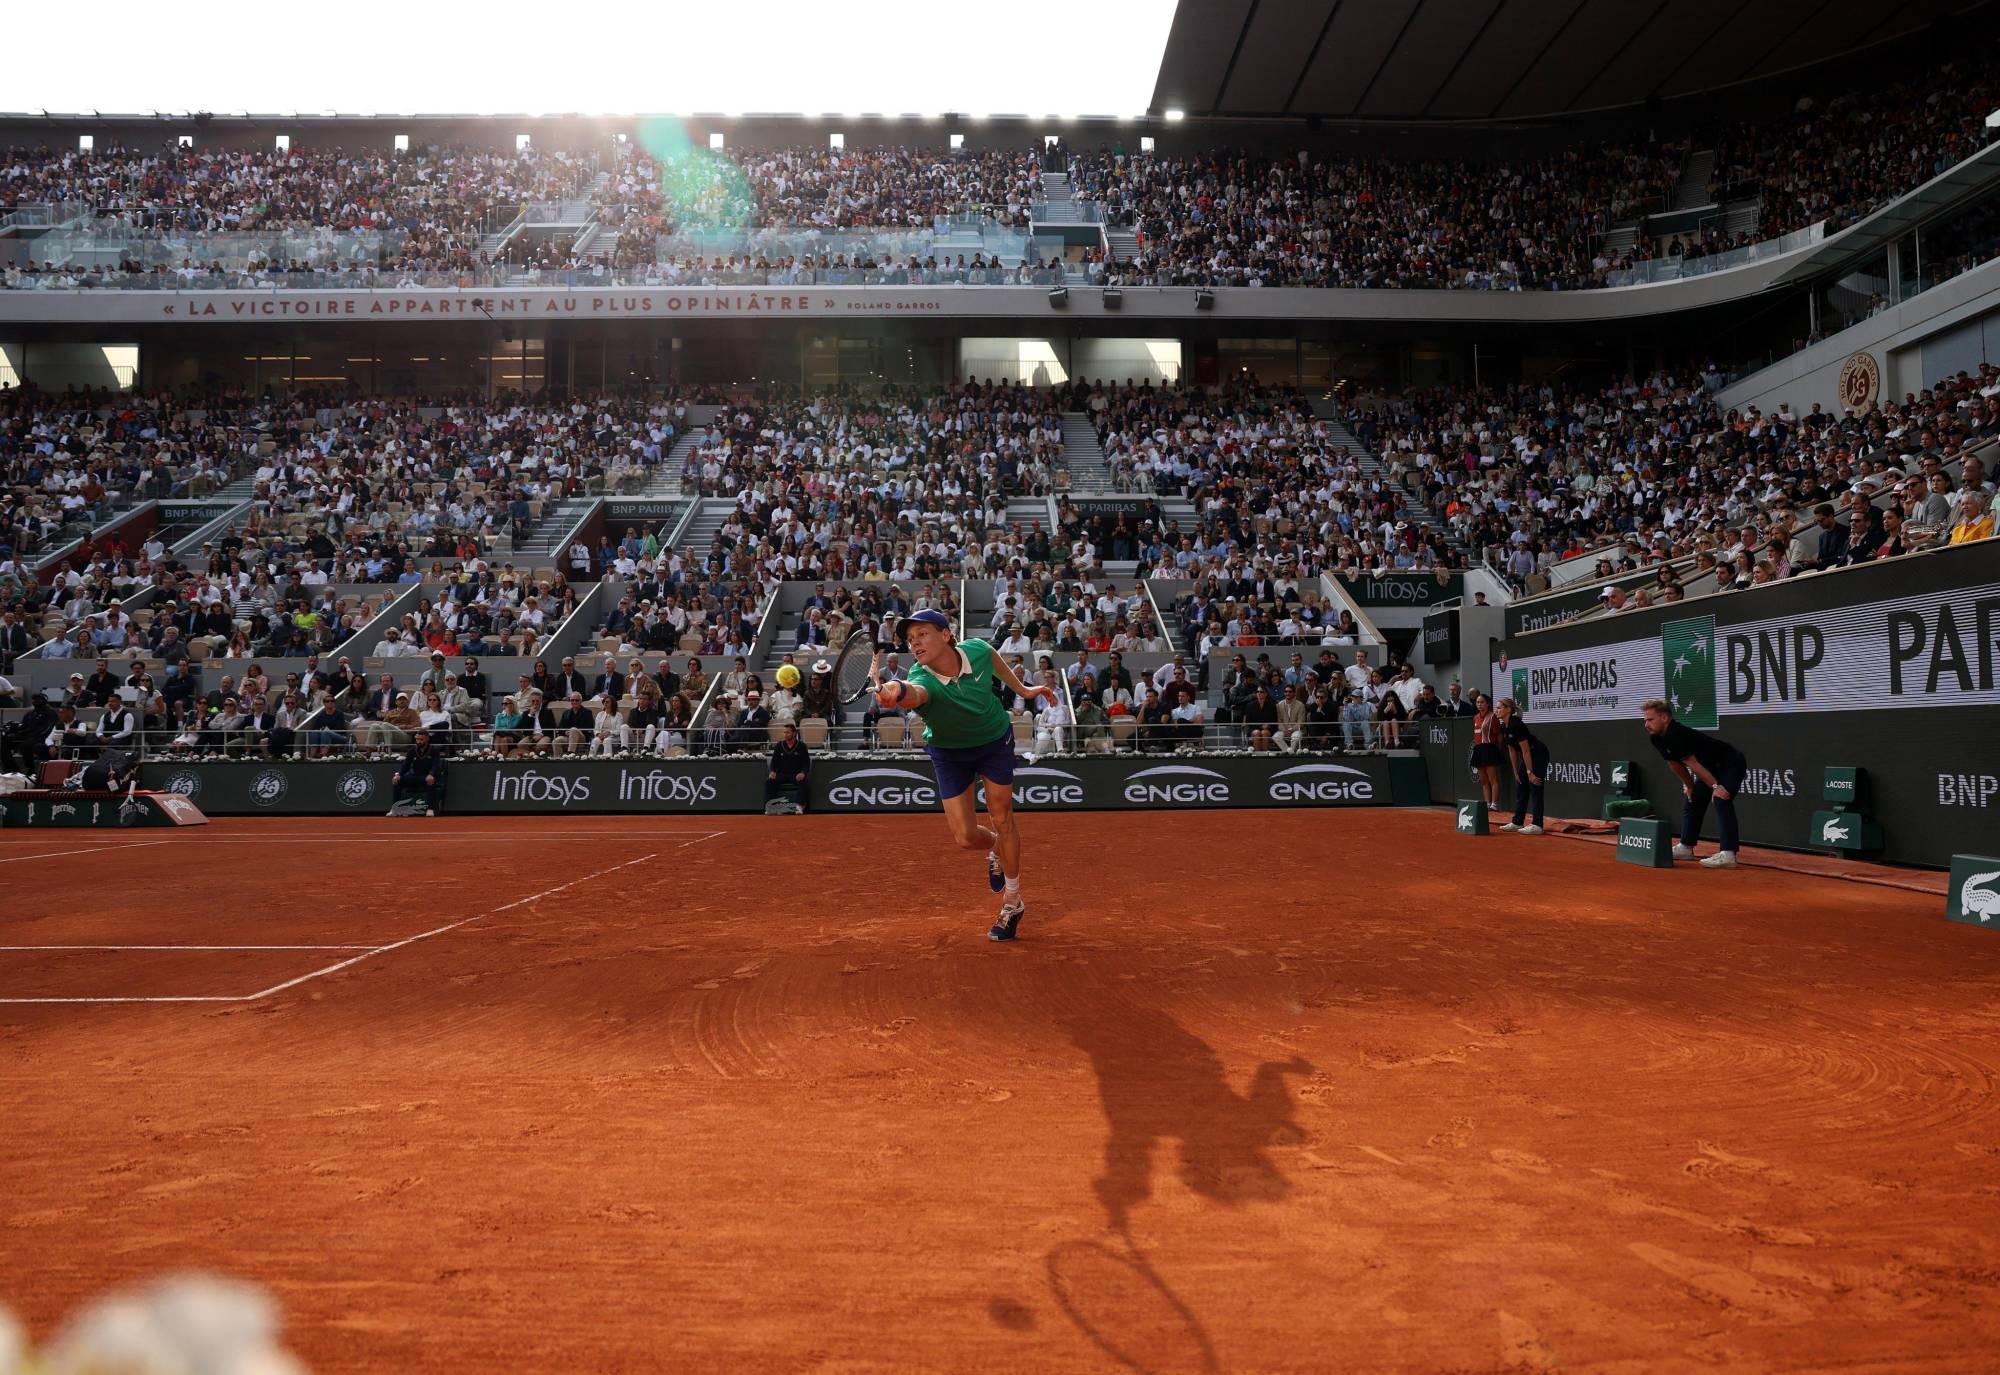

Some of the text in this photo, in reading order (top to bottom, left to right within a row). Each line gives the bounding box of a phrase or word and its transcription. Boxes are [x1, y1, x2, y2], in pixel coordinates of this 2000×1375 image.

[189, 301, 217, 315] LA
[231, 300, 355, 314] VICTOIRE
[546, 298, 577, 312] AU
[592, 298, 652, 311] PLUS
[667, 293, 810, 311] OPINIÂTRE
[1857, 356, 1877, 387] GARROS
[165, 508, 225, 518] BNP PARIB
[612, 505, 636, 514] BNP
[1089, 503, 1137, 512] PARIBAS
[1366, 578, 1429, 602] Infosys
[1726, 623, 1825, 704] BNP
[1532, 659, 1618, 695] BNP PARIBAS
[1555, 763, 1601, 785] PARIBAS
[1825, 781, 1853, 789] LACOSTE
[492, 770, 590, 805] Infosys
[619, 769, 717, 805] Infosys
[1938, 774, 1999, 807] BNP
[1620, 835, 1652, 849] LACOSTE
